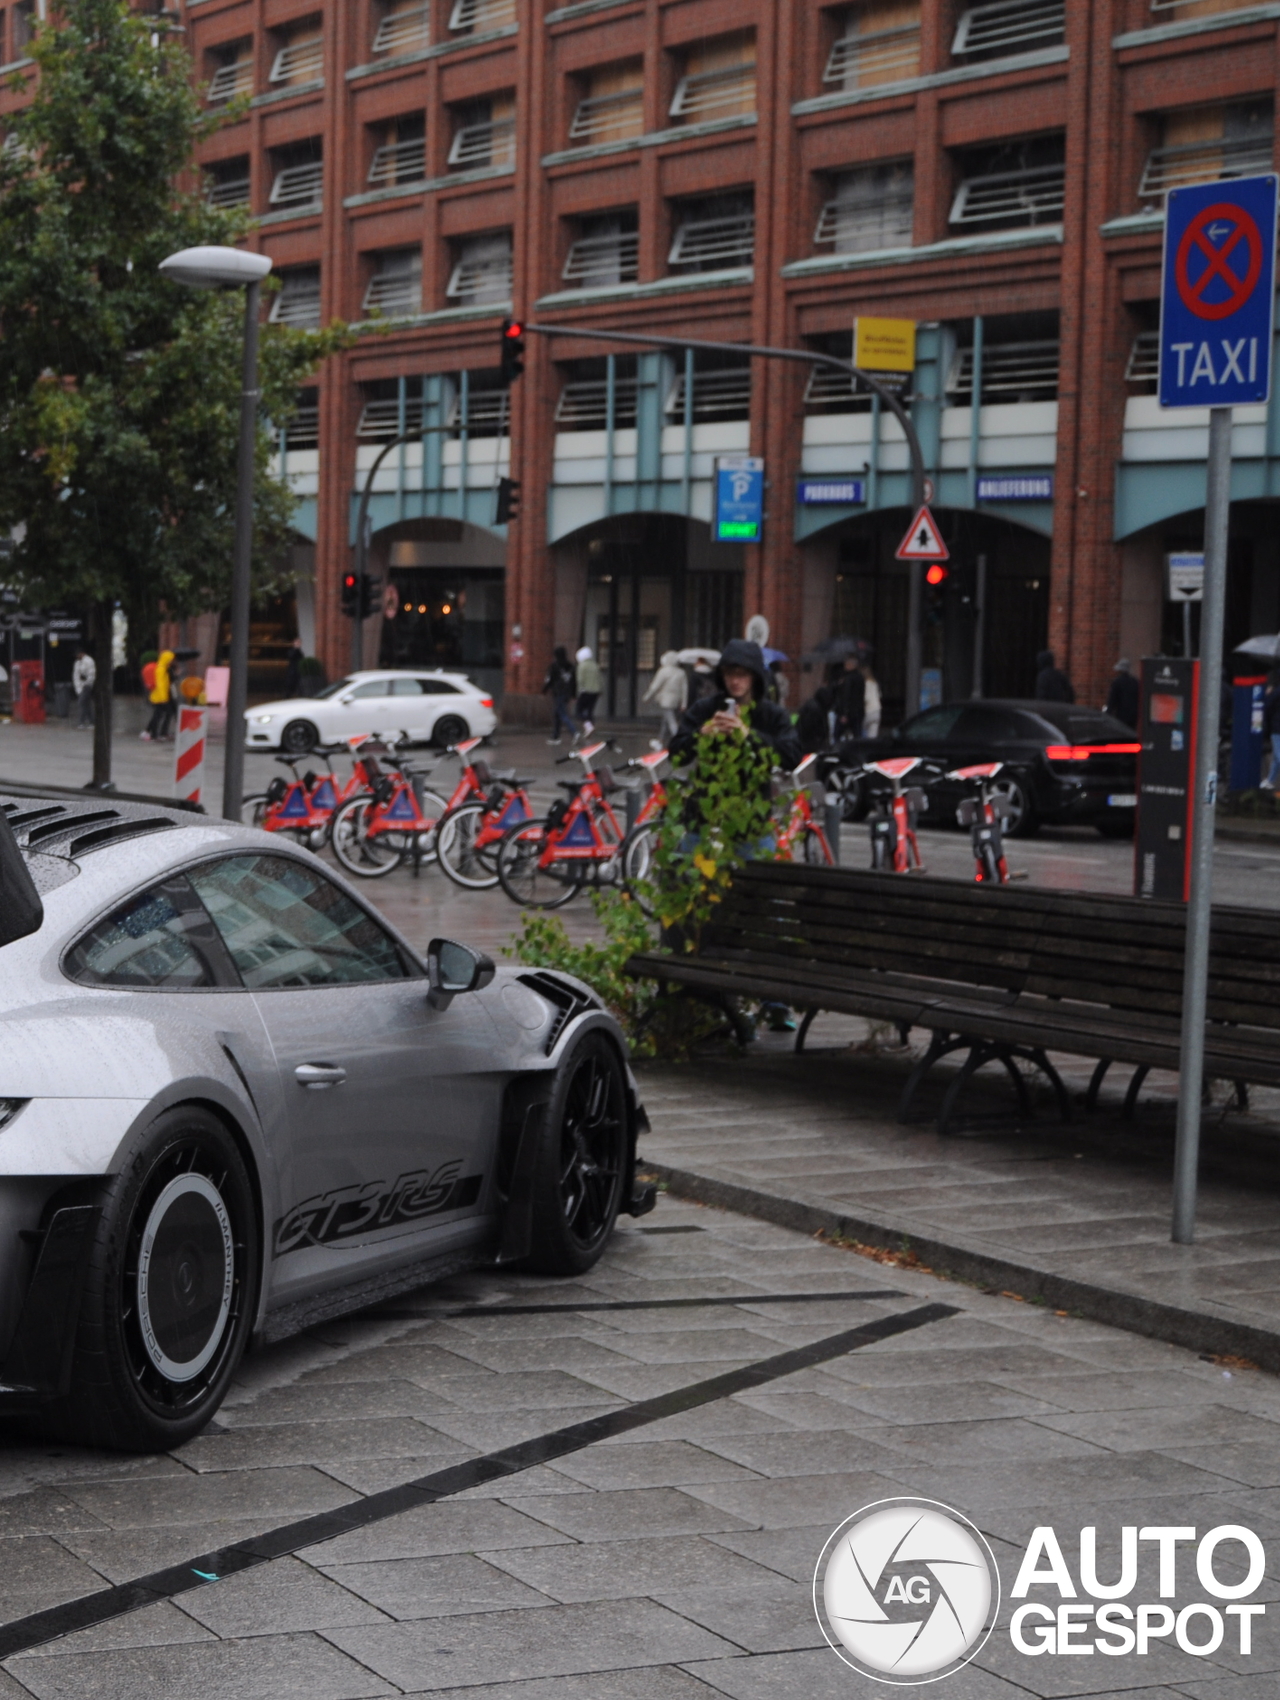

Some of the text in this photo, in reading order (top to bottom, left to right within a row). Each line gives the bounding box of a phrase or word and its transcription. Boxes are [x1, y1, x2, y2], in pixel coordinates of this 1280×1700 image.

[1171, 337, 1258, 388] TAXI
[733, 480, 750, 502] P
[220, 1216, 234, 1308] MANTHEY
